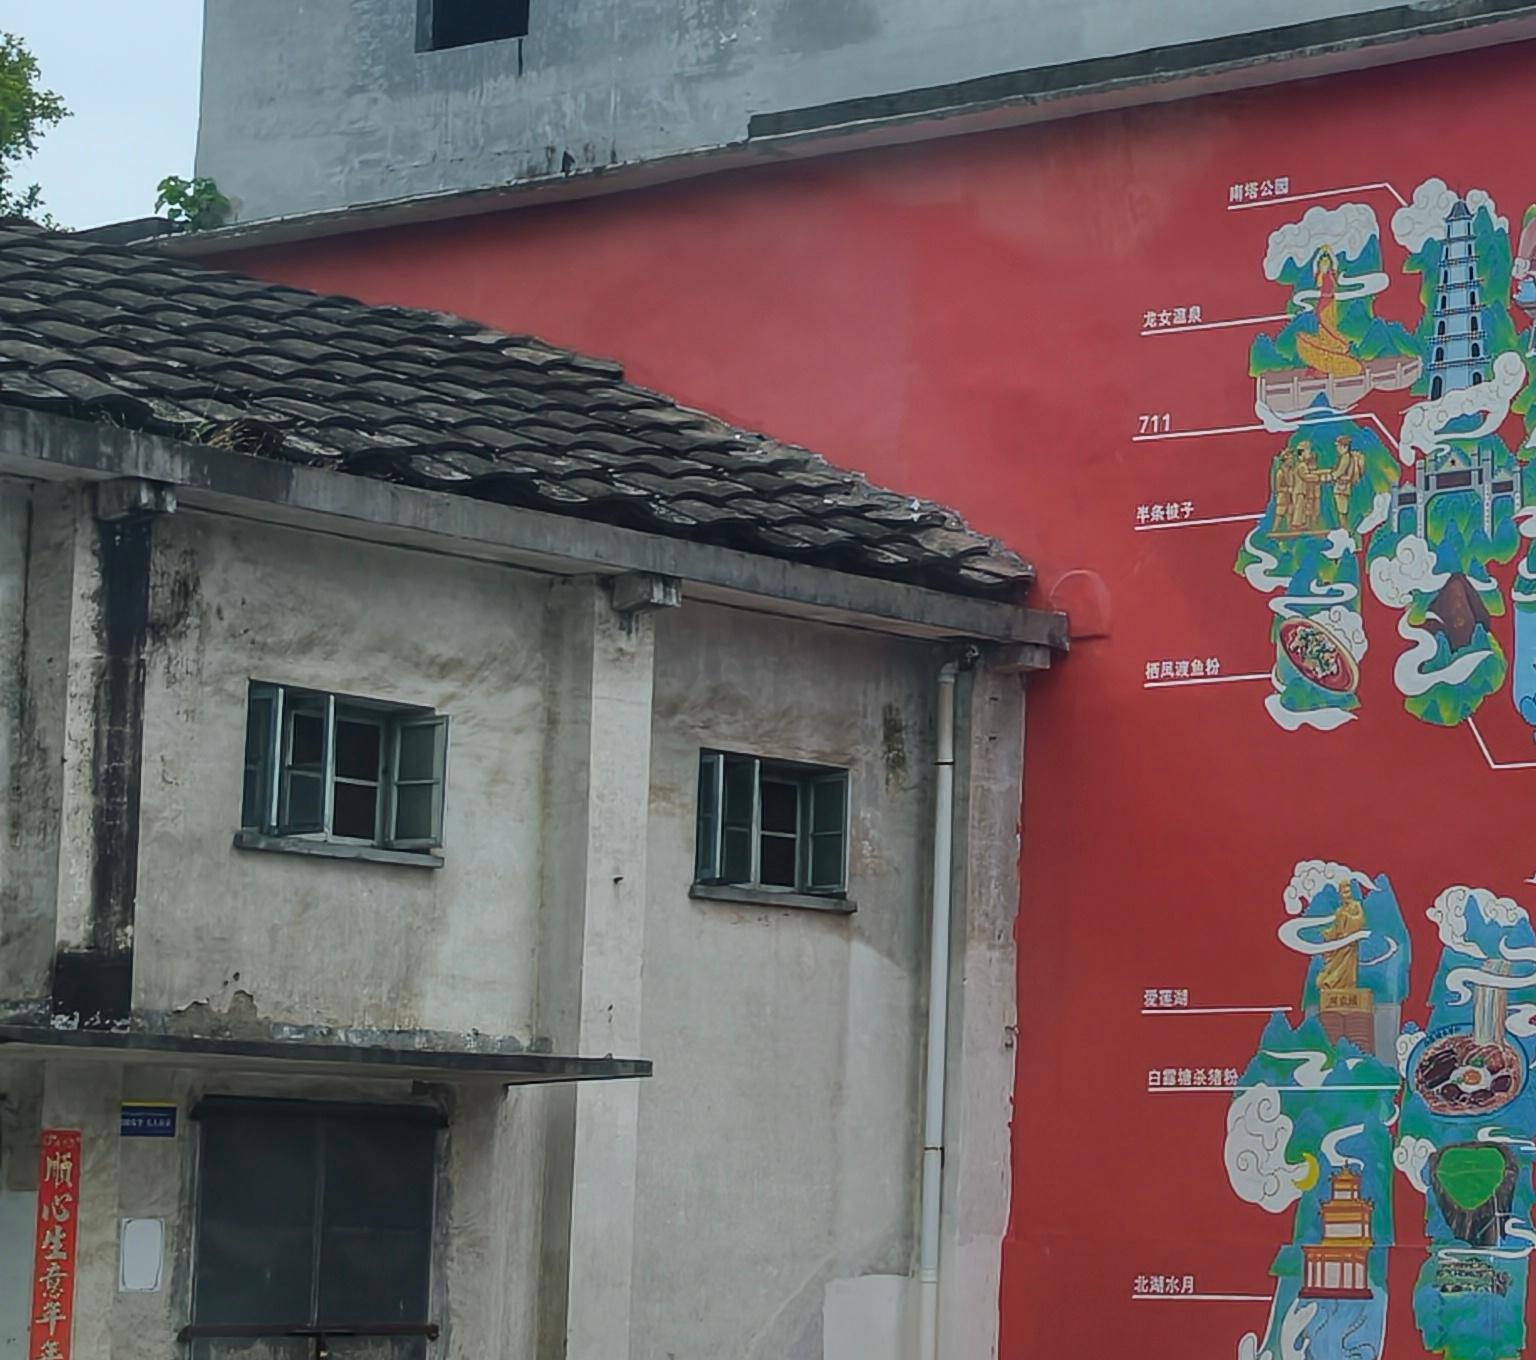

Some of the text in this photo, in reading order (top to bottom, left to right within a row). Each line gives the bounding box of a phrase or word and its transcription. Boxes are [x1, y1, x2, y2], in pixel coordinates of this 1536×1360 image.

[1143, 305, 1202, 328] 龙女温泉
[1138, 412, 1170, 433] 711
[1133, 1275, 1194, 1294] 北湖水月
